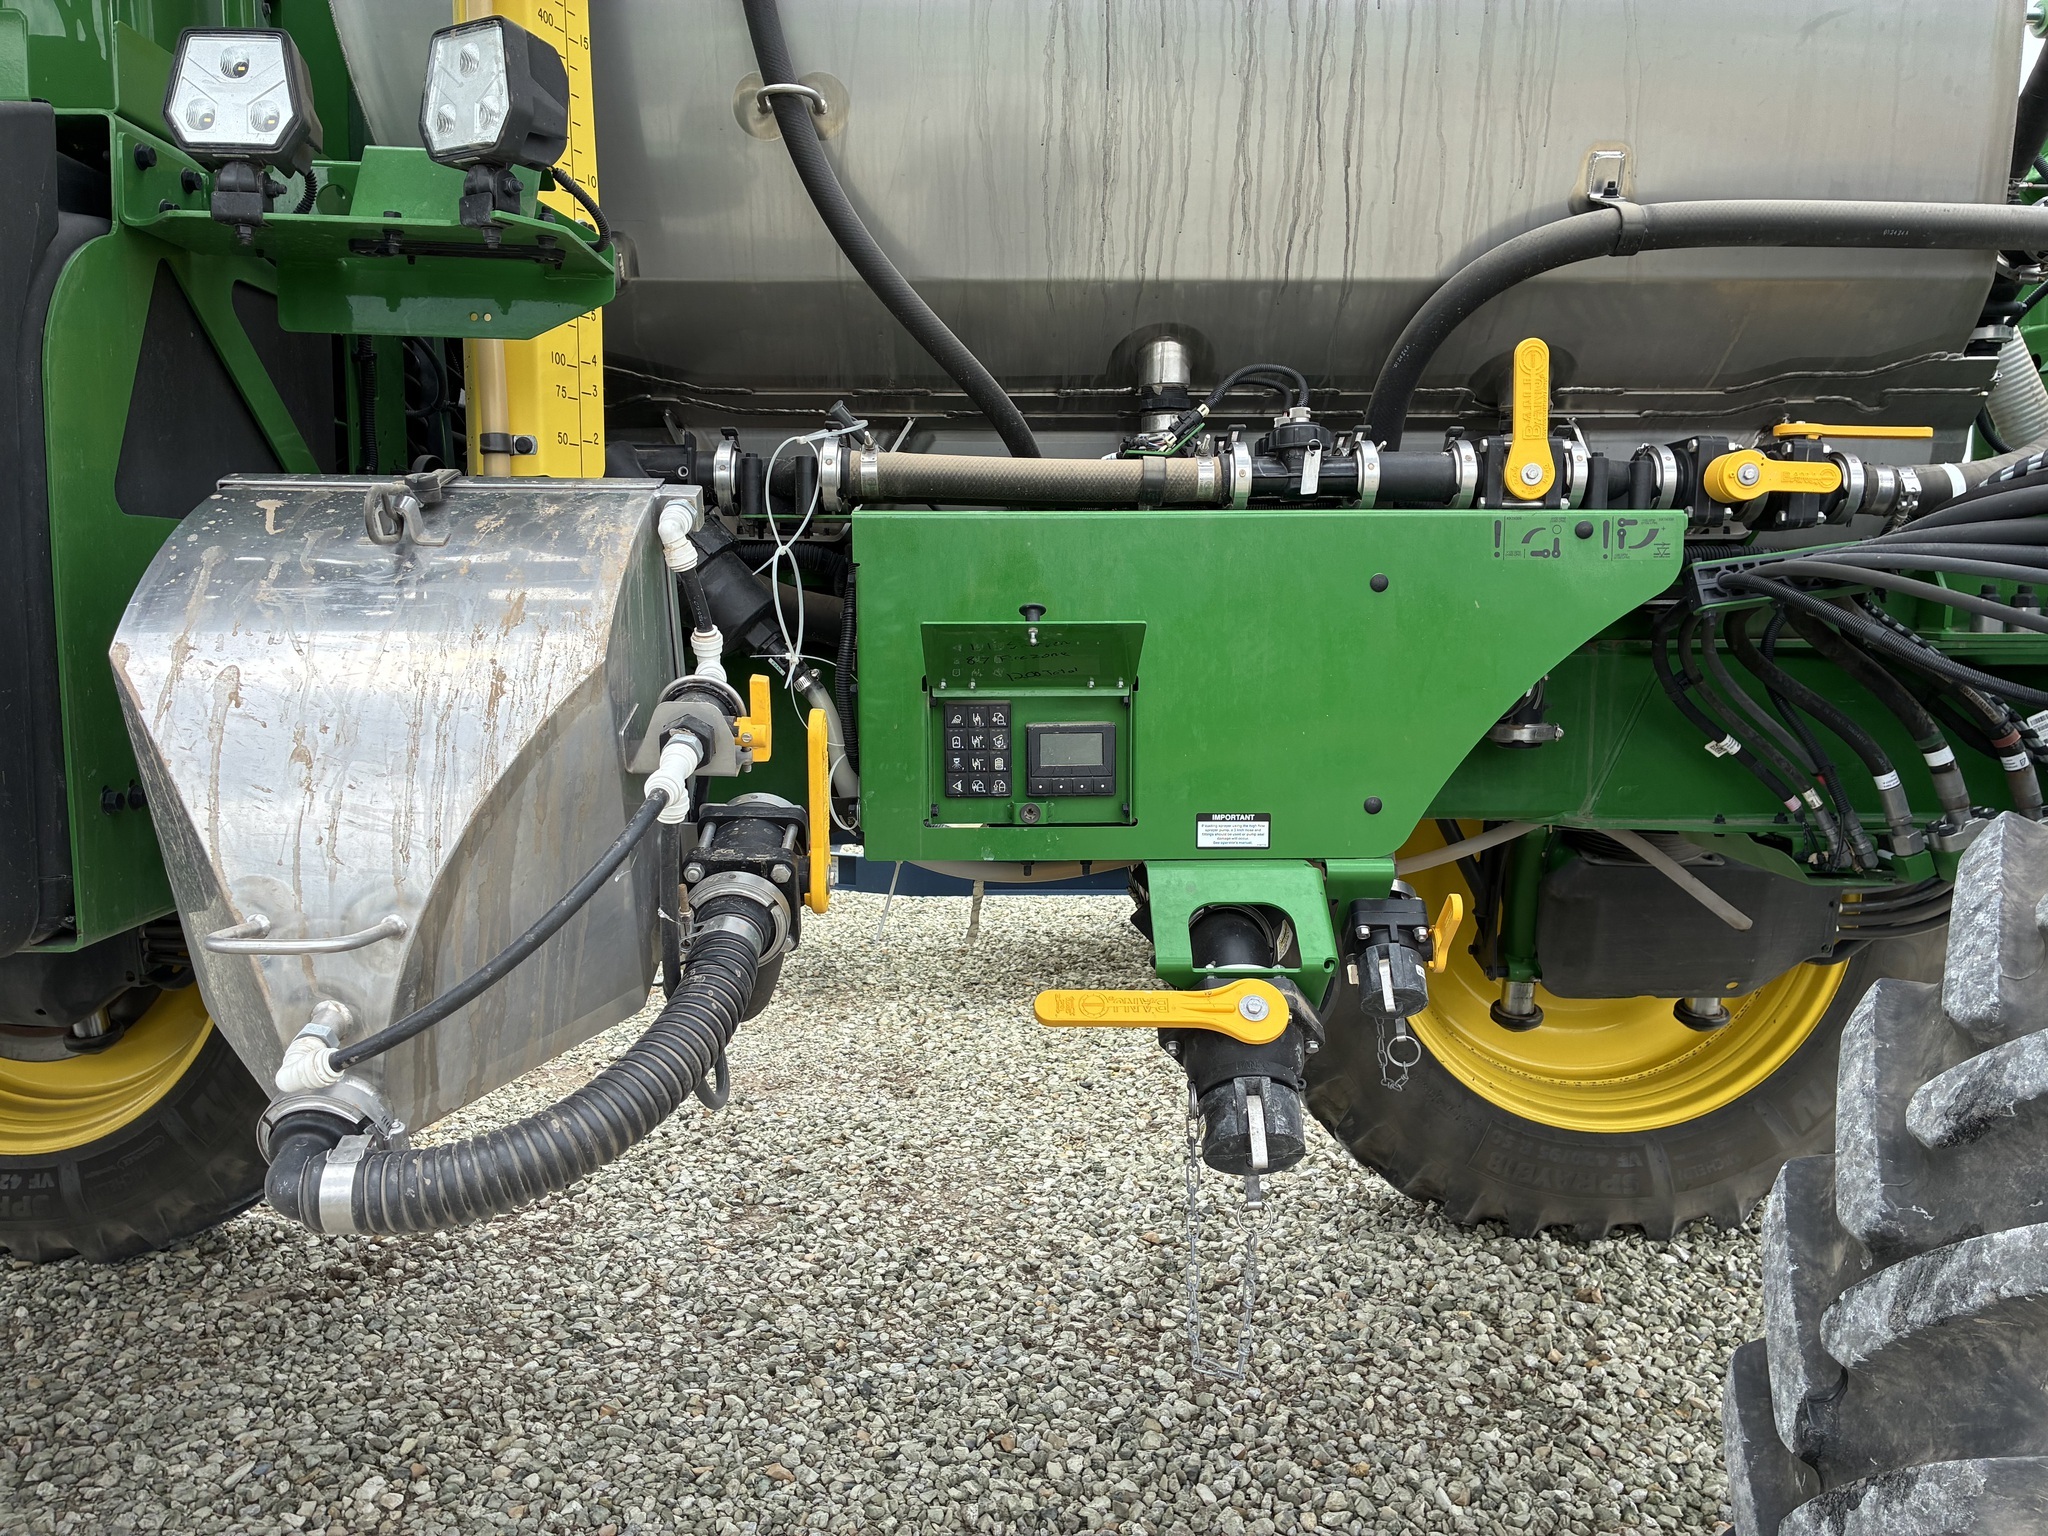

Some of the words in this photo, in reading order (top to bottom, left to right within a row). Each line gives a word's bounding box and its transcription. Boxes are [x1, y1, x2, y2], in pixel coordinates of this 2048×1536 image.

[537, 7, 554, 27] 400
[579, 34, 590, 51] 15
[586, 175, 597, 189] 10
[551, 351, 566, 367] 100
[591, 355, 597, 366] 4
[556, 385, 567, 399] 75
[592, 385, 598, 398] 3
[557, 432, 569, 445] 50
[593, 433, 599, 445] 2
